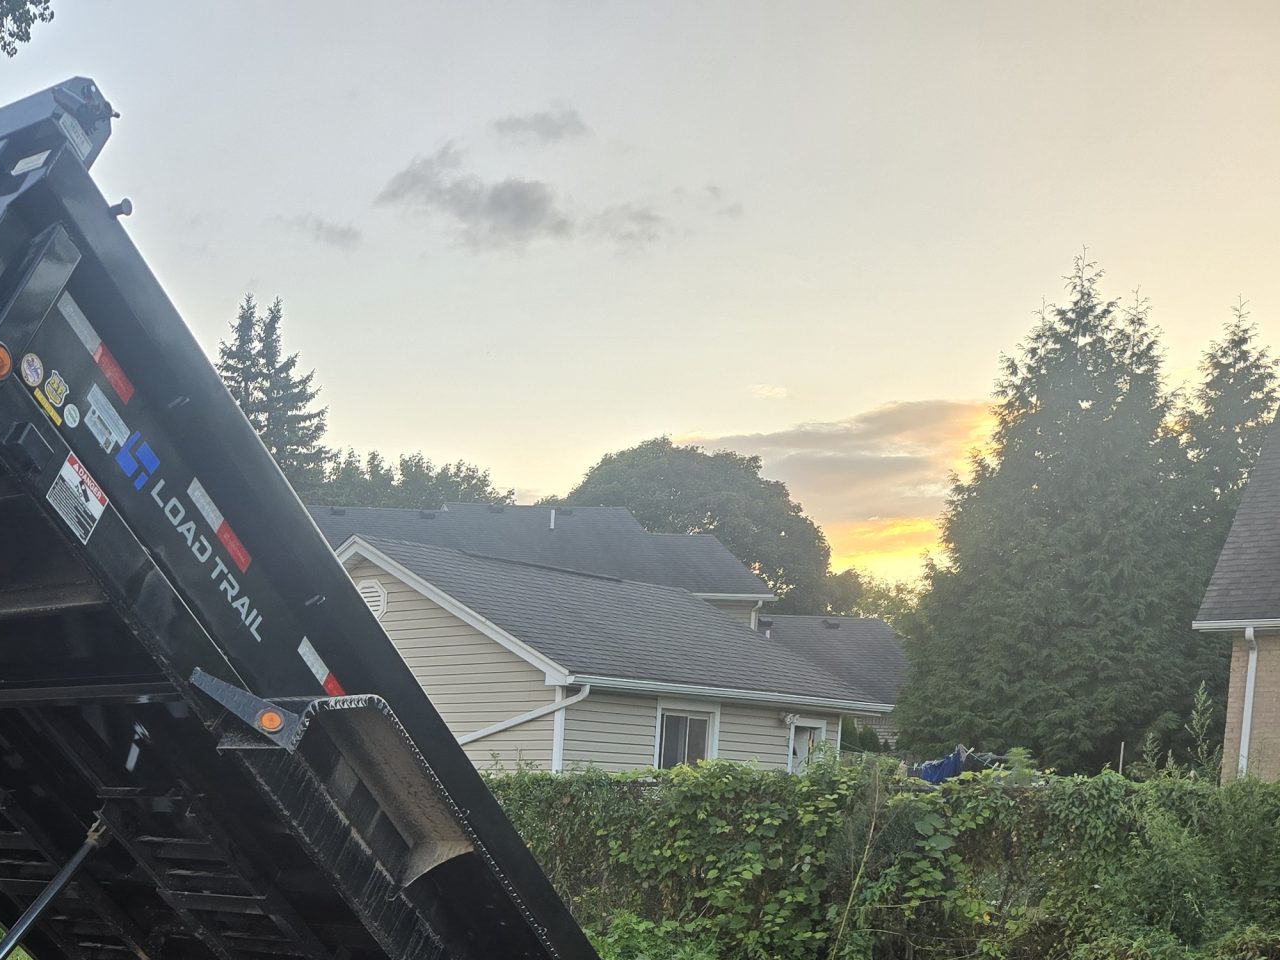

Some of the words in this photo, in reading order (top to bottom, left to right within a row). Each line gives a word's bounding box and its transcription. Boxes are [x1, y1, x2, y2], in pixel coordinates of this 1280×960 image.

[78, 468, 102, 500] DANGER
[150, 478, 213, 563] LOAD
[210, 556, 263, 643] TRAIL
